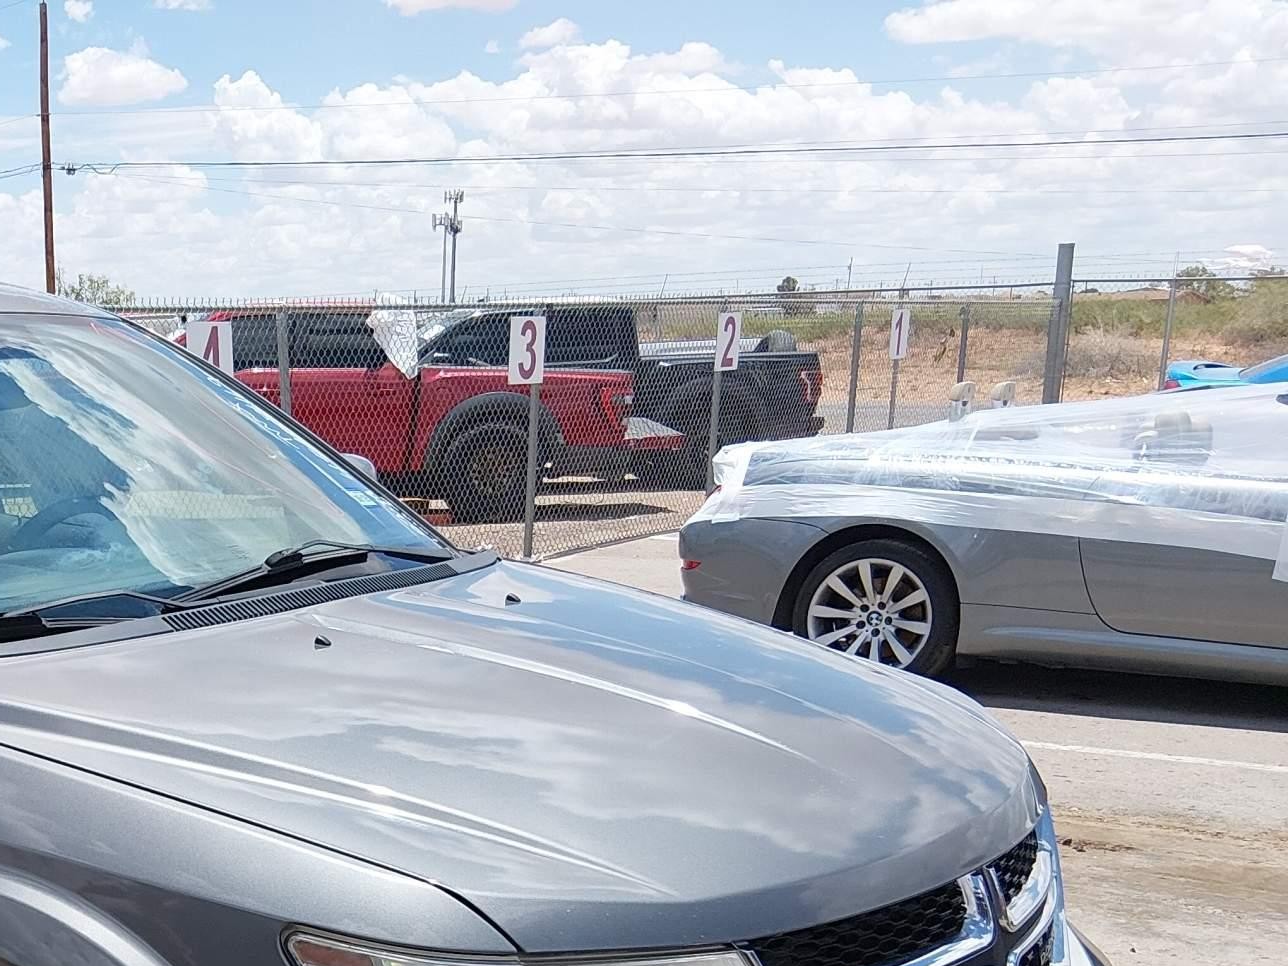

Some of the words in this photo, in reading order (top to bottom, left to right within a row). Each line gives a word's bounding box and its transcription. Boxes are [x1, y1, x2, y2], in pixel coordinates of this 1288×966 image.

[518, 319, 537, 380] 3
[720, 315, 736, 368] 2
[895, 311, 904, 356] 1
